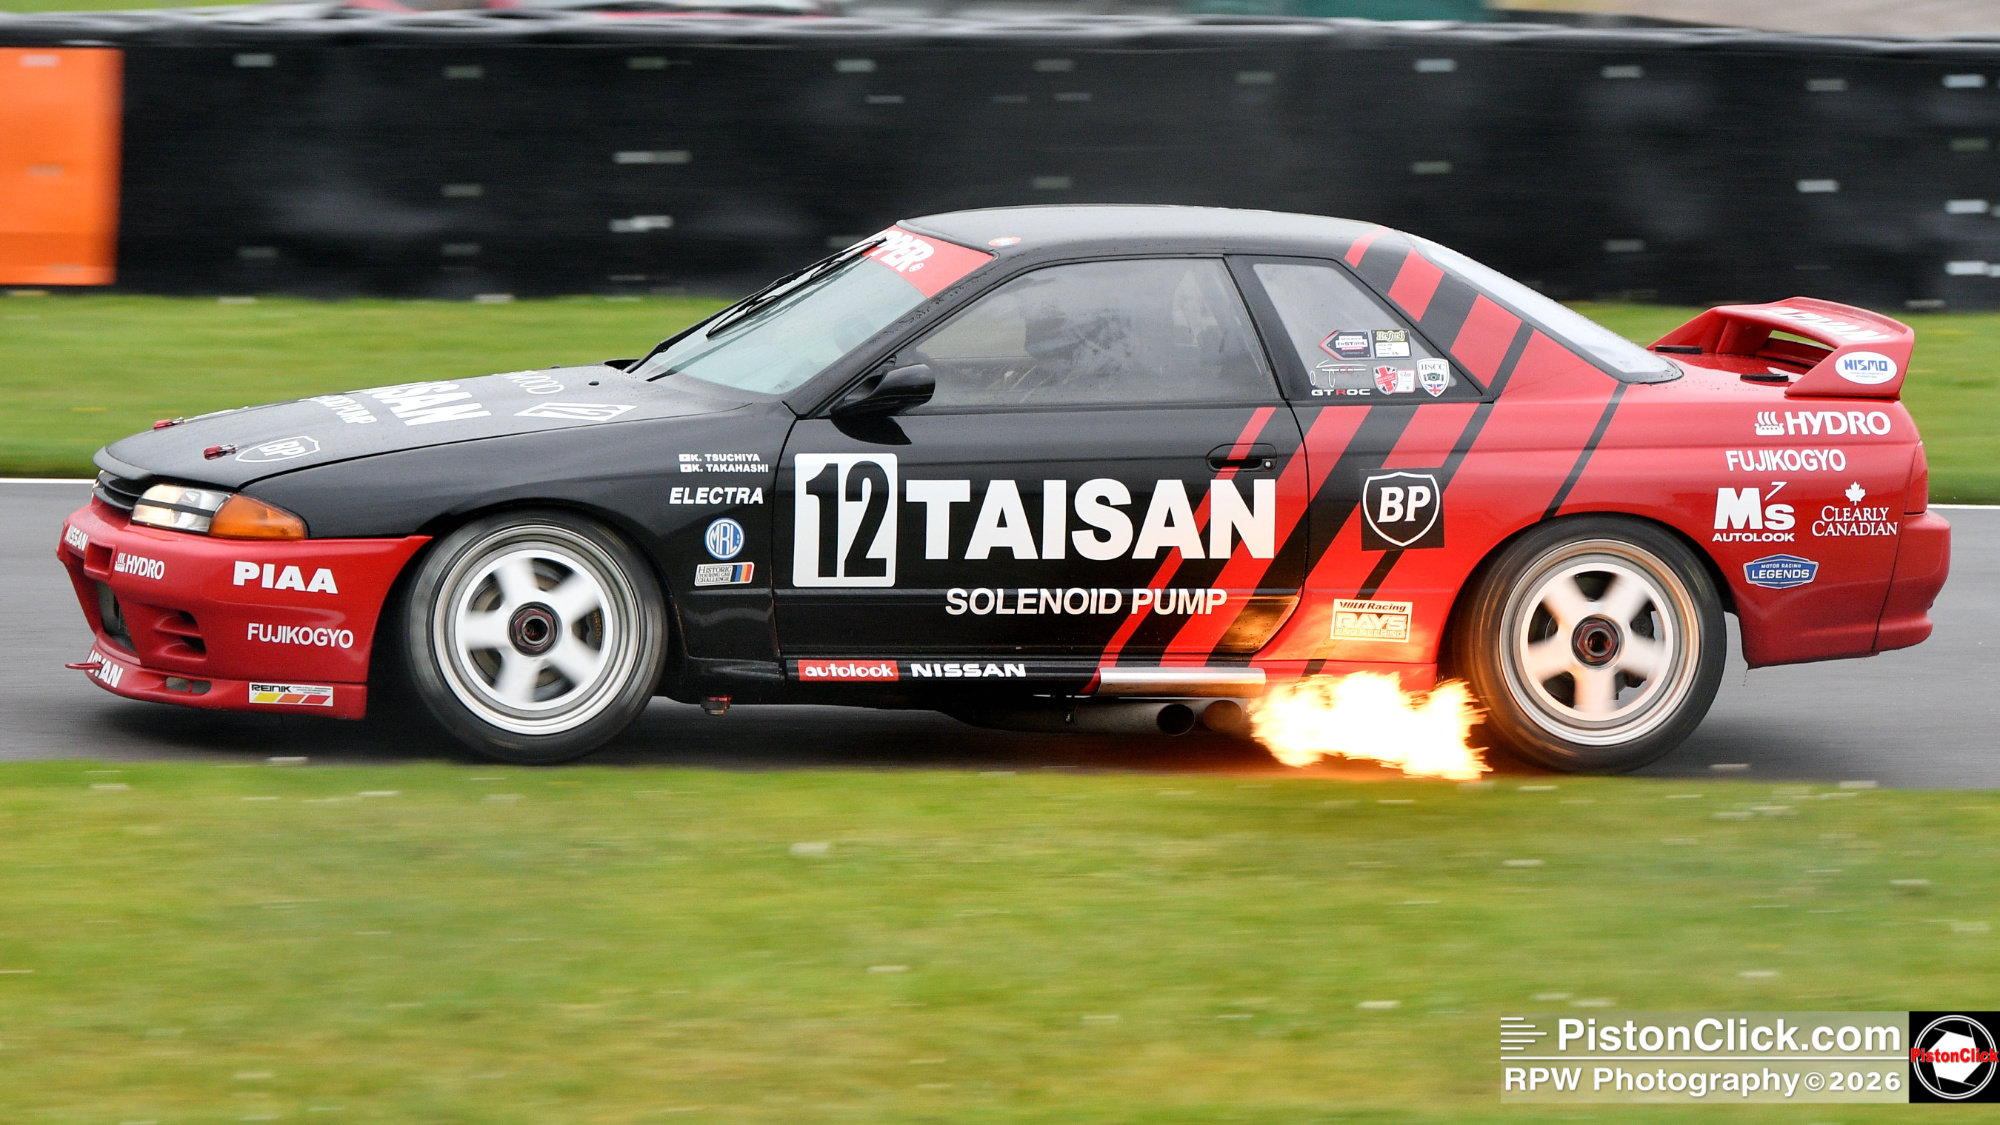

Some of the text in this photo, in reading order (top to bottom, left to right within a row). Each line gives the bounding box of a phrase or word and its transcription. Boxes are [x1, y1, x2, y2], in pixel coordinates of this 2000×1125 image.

[1844, 359, 1888, 372] NISMO
[1786, 411, 1891, 436] HYDRO
[259, 440, 306, 457] BP
[704, 453, 761, 462] TSUCHIYA
[1726, 449, 1847, 472] FUJIKOGYO
[705, 463, 769, 472] TAKAHASHI
[669, 487, 764, 504] ELECTRA
[1379, 486, 1433, 523] BP
[806, 462, 890, 578] 12
[906, 479, 1276, 560] TAISAN
[1821, 506, 1890, 522] CLEARLY
[1712, 532, 1795, 542] AUTOLOOK
[1811, 520, 1898, 537] CANADIAN
[65, 525, 89, 551] NISSAN
[125, 554, 165, 580] HYDRO
[1751, 569, 1810, 579] LEGENDS
[233, 561, 339, 594] PIAA
[945, 588, 1228, 615] SOLENOID PUMP
[1367, 603, 1406, 612] Racing
[247, 622, 354, 649] FUJIKOGYO
[805, 663, 894, 677] autolook
[910, 663, 1027, 678] NISSAN
